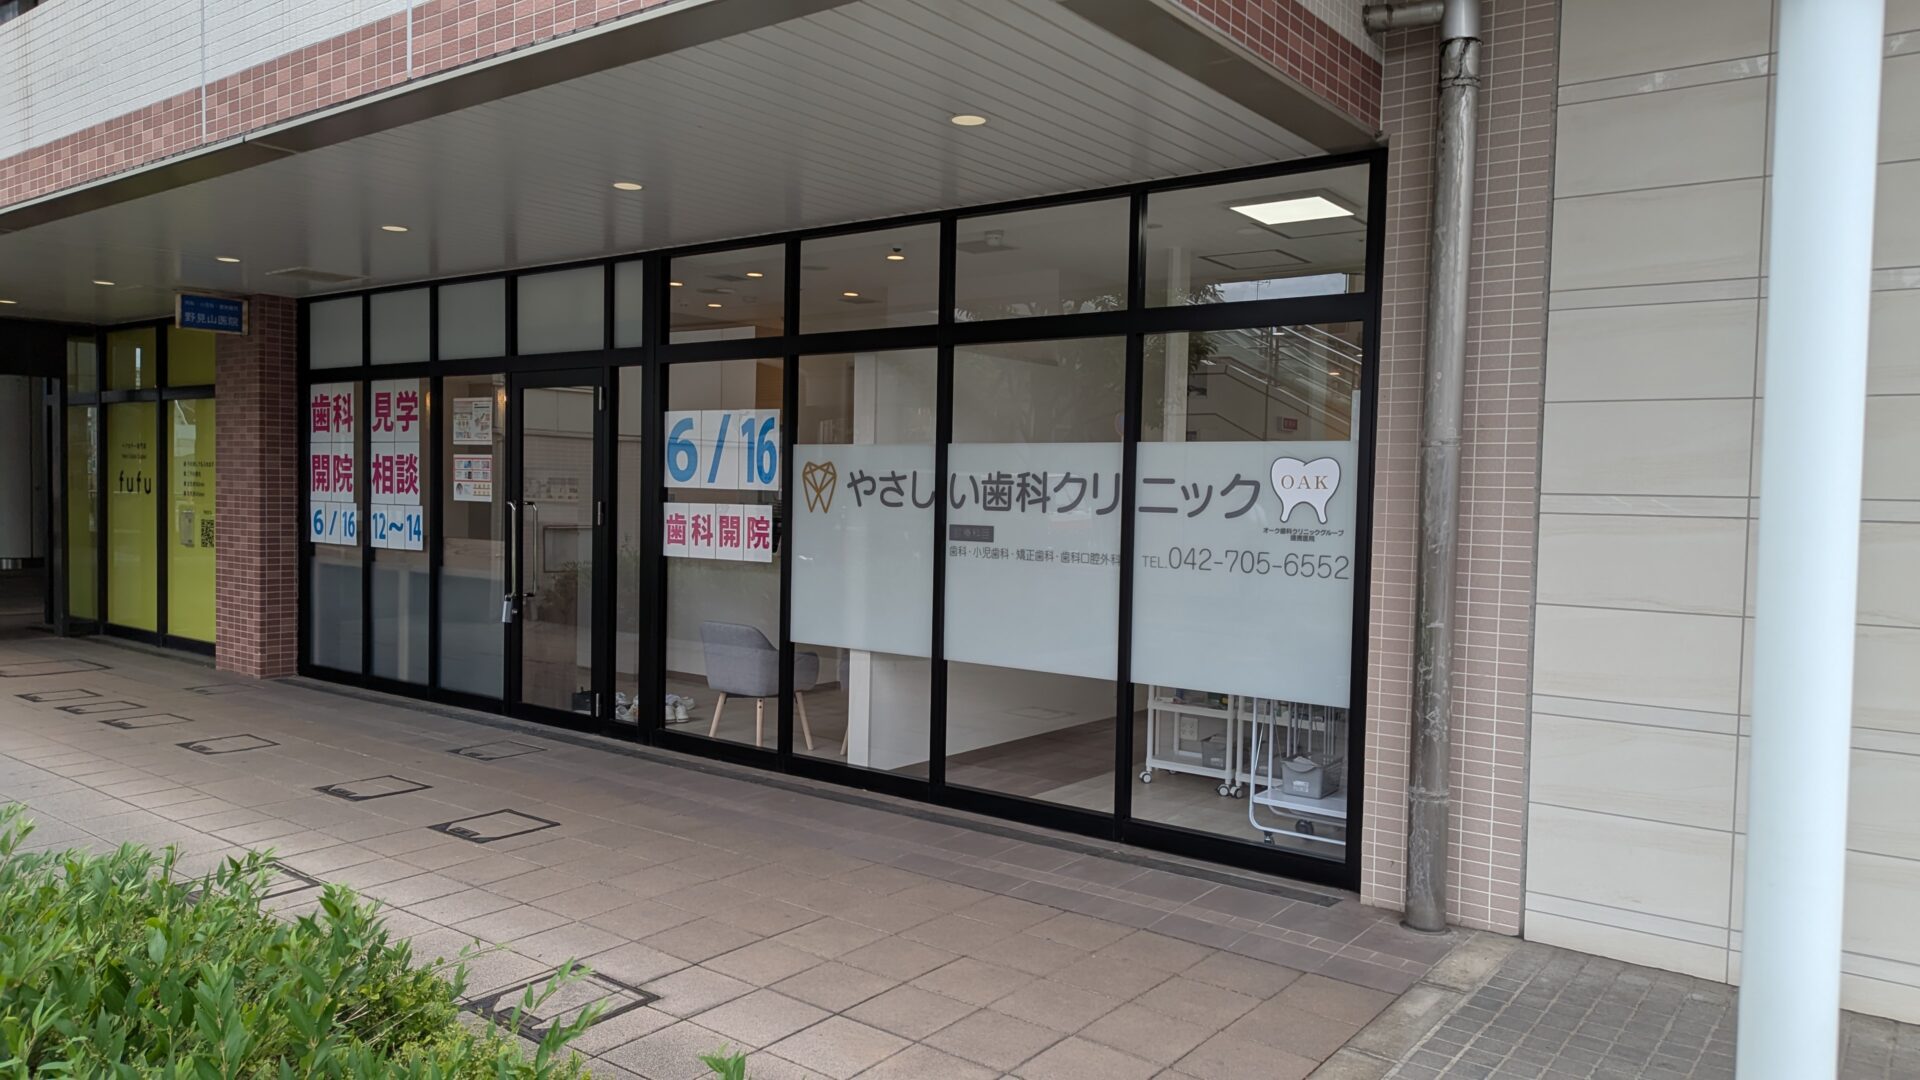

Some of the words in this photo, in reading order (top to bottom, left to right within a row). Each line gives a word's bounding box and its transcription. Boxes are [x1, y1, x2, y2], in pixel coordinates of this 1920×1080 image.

[311, 393, 354, 433] 歯科
[372, 390, 419, 432] 見学
[667, 413, 778, 485] 6/16
[119, 470, 151, 494] fufu
[311, 452, 354, 493] 開院
[372, 453, 420, 495] 相談
[1280, 474, 1329, 490] OAK
[846, 469, 1261, 519] やさしい歯科クリニック
[312, 508, 355, 538] 6/16
[667, 513, 770, 549] 歯科開院
